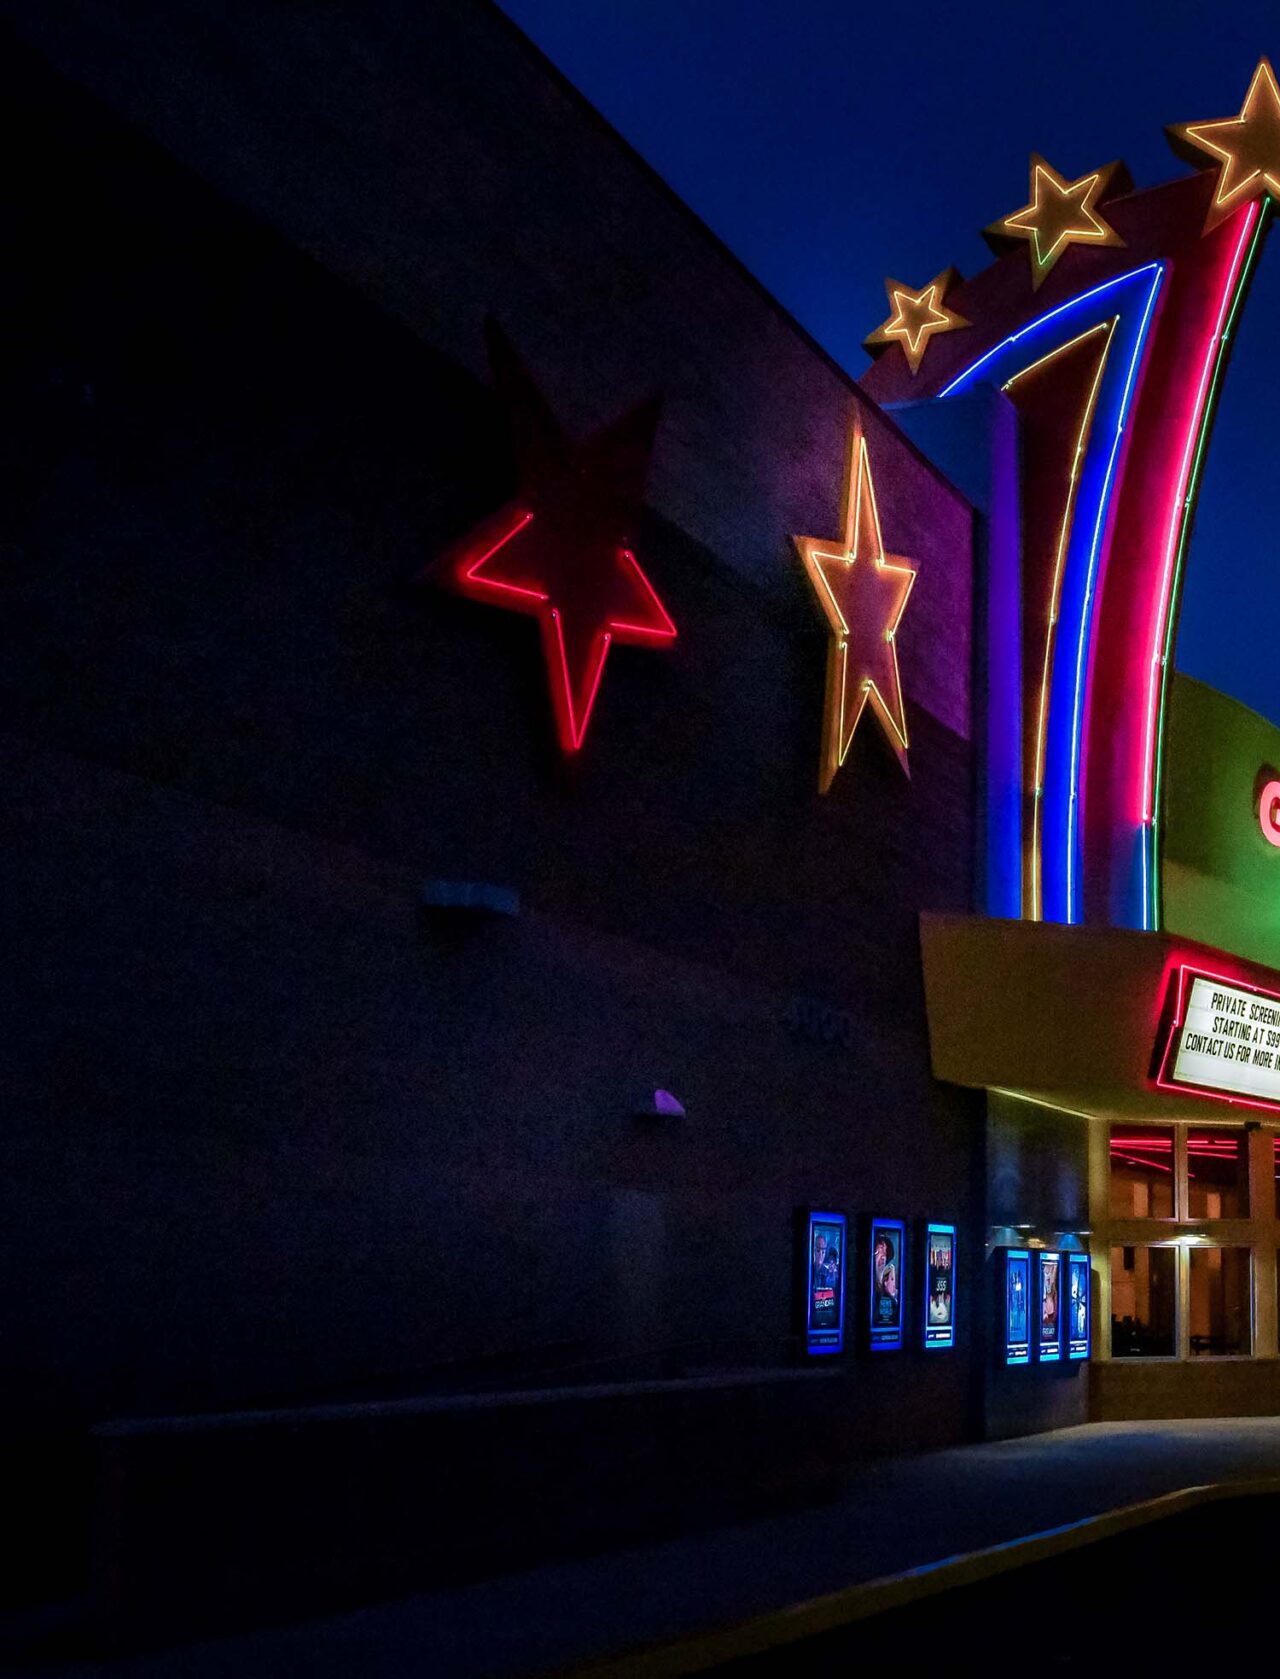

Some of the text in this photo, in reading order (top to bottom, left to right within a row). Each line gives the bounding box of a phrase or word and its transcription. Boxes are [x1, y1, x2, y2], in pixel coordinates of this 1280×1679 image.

[1211, 993, 1247, 1018] PRIVATE
[1212, 1016, 1250, 1041] STARTING
[1252, 1028, 1265, 1045] AT
[1185, 1033, 1224, 1057] CONTACT
[1224, 1043, 1236, 1059] US
[1236, 1045, 1250, 1064] FOR
[1252, 1049, 1274, 1068] MORE
